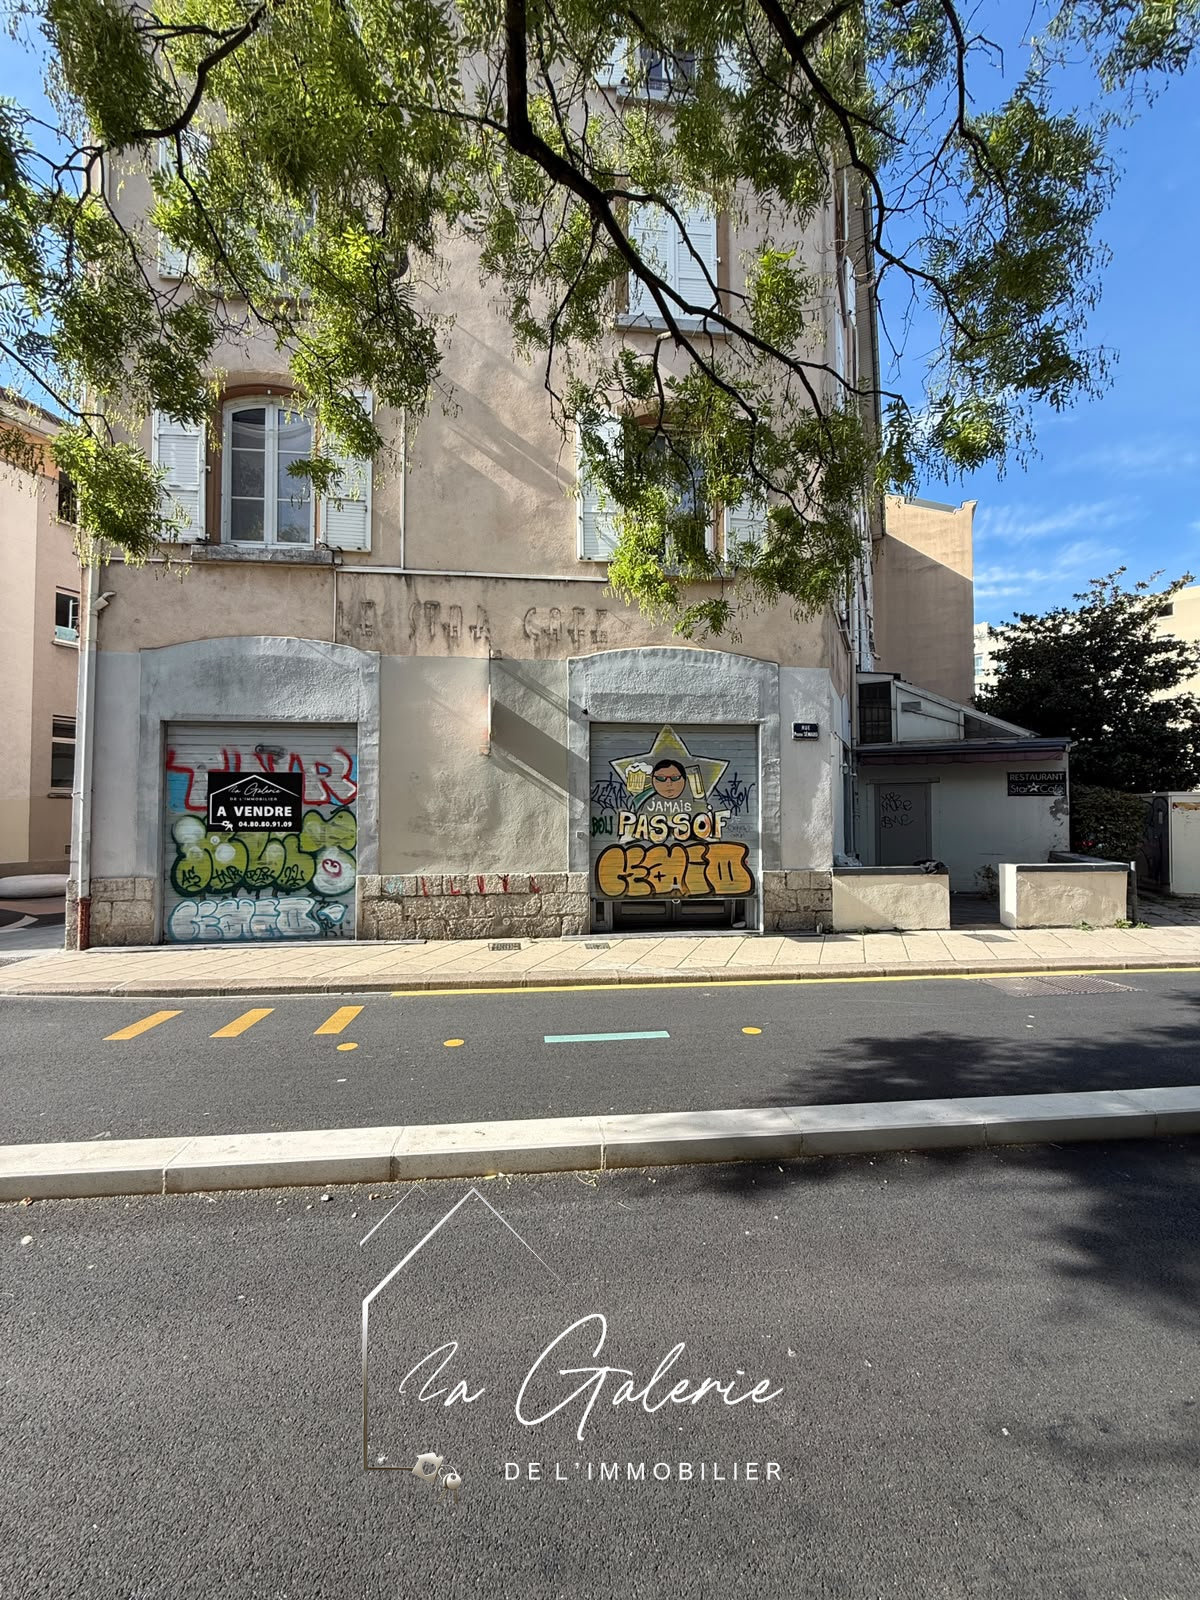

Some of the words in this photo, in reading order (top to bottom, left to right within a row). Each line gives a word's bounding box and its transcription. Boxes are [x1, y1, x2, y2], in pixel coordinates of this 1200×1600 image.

[1010, 773, 1065, 781] RESTAURANT
[244, 782, 281, 797] Galerie
[1010, 784, 1028, 794] Star
[216, 806, 227, 817] A
[233, 806, 293, 817] VENDRE
